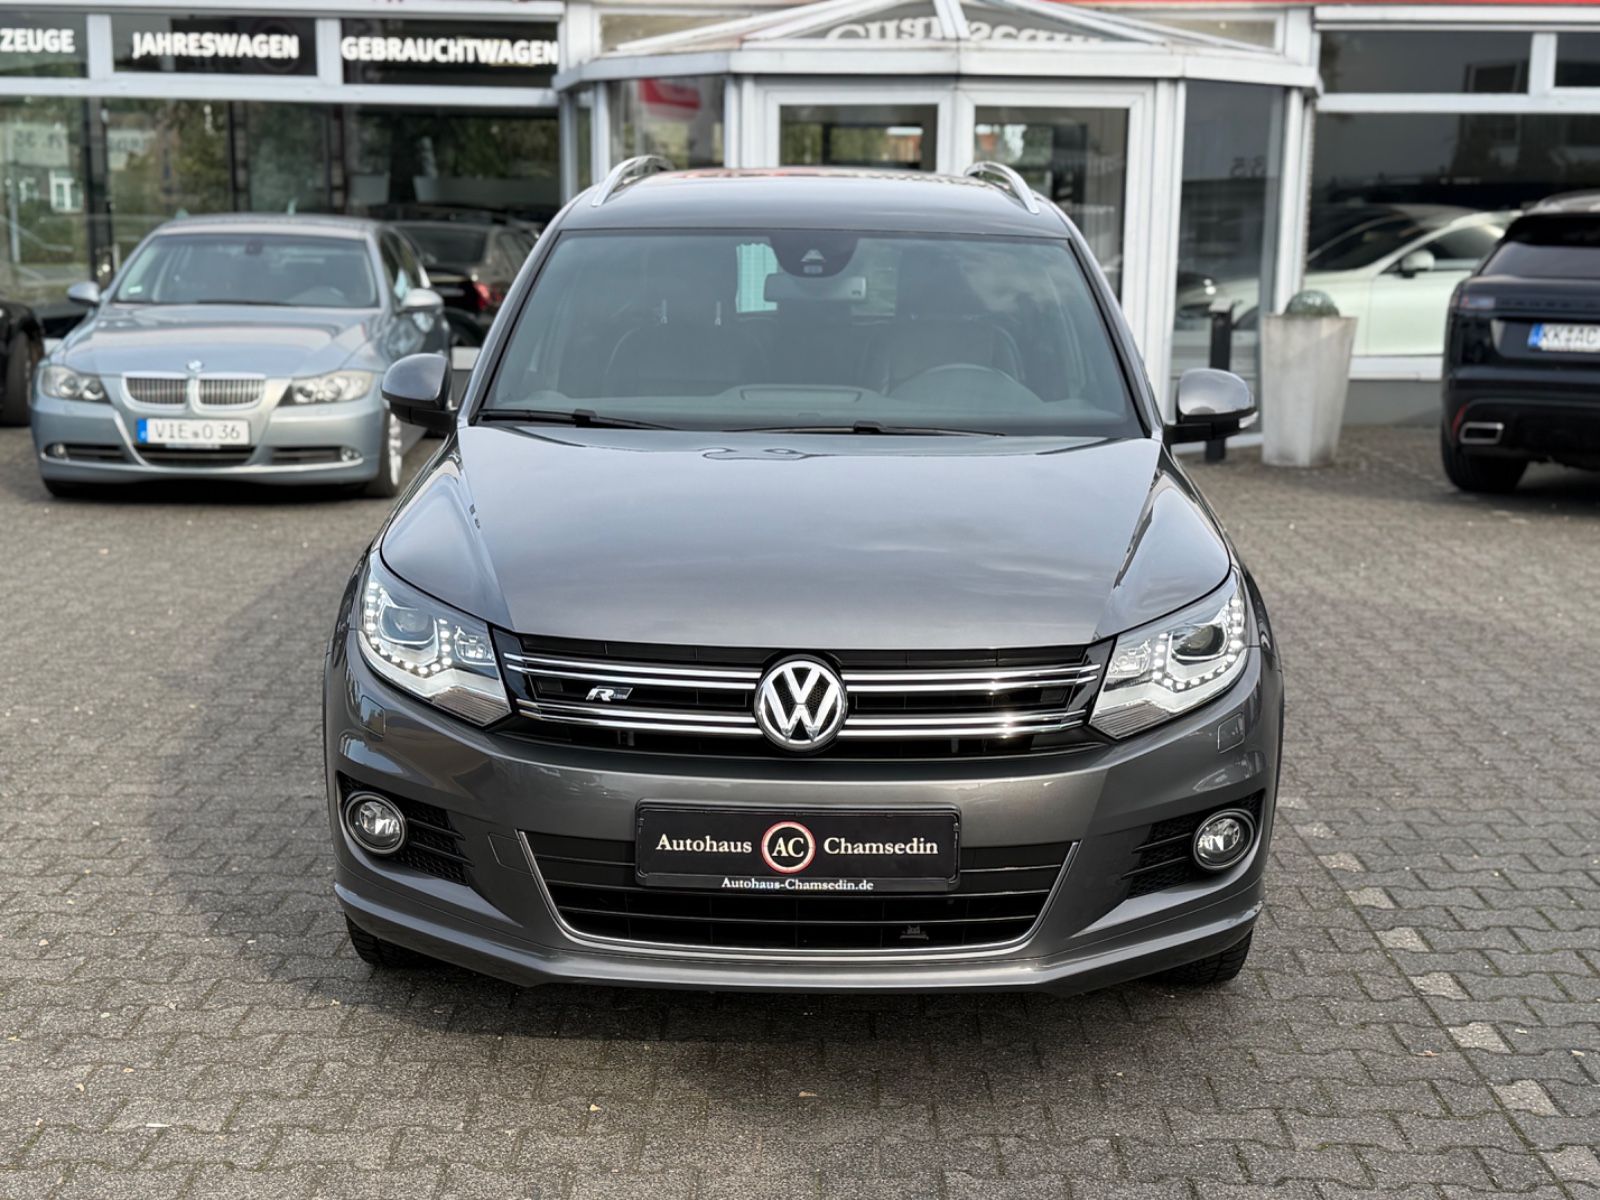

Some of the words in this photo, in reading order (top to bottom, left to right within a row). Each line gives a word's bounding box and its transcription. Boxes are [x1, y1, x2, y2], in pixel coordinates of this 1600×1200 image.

[0, 28, 75, 53] ZEUGE
[132, 32, 299, 60] JAHRESWAGEN
[341, 36, 559, 65] GEBRAUCHTWAGEN
[155, 423, 189, 440] VIE
[655, 833, 753, 854] Autohaus
[771, 837, 805, 858] AC
[823, 836, 939, 855] Chamsedin
[720, 877, 875, 891] Autohaus-Chamsedin.de
